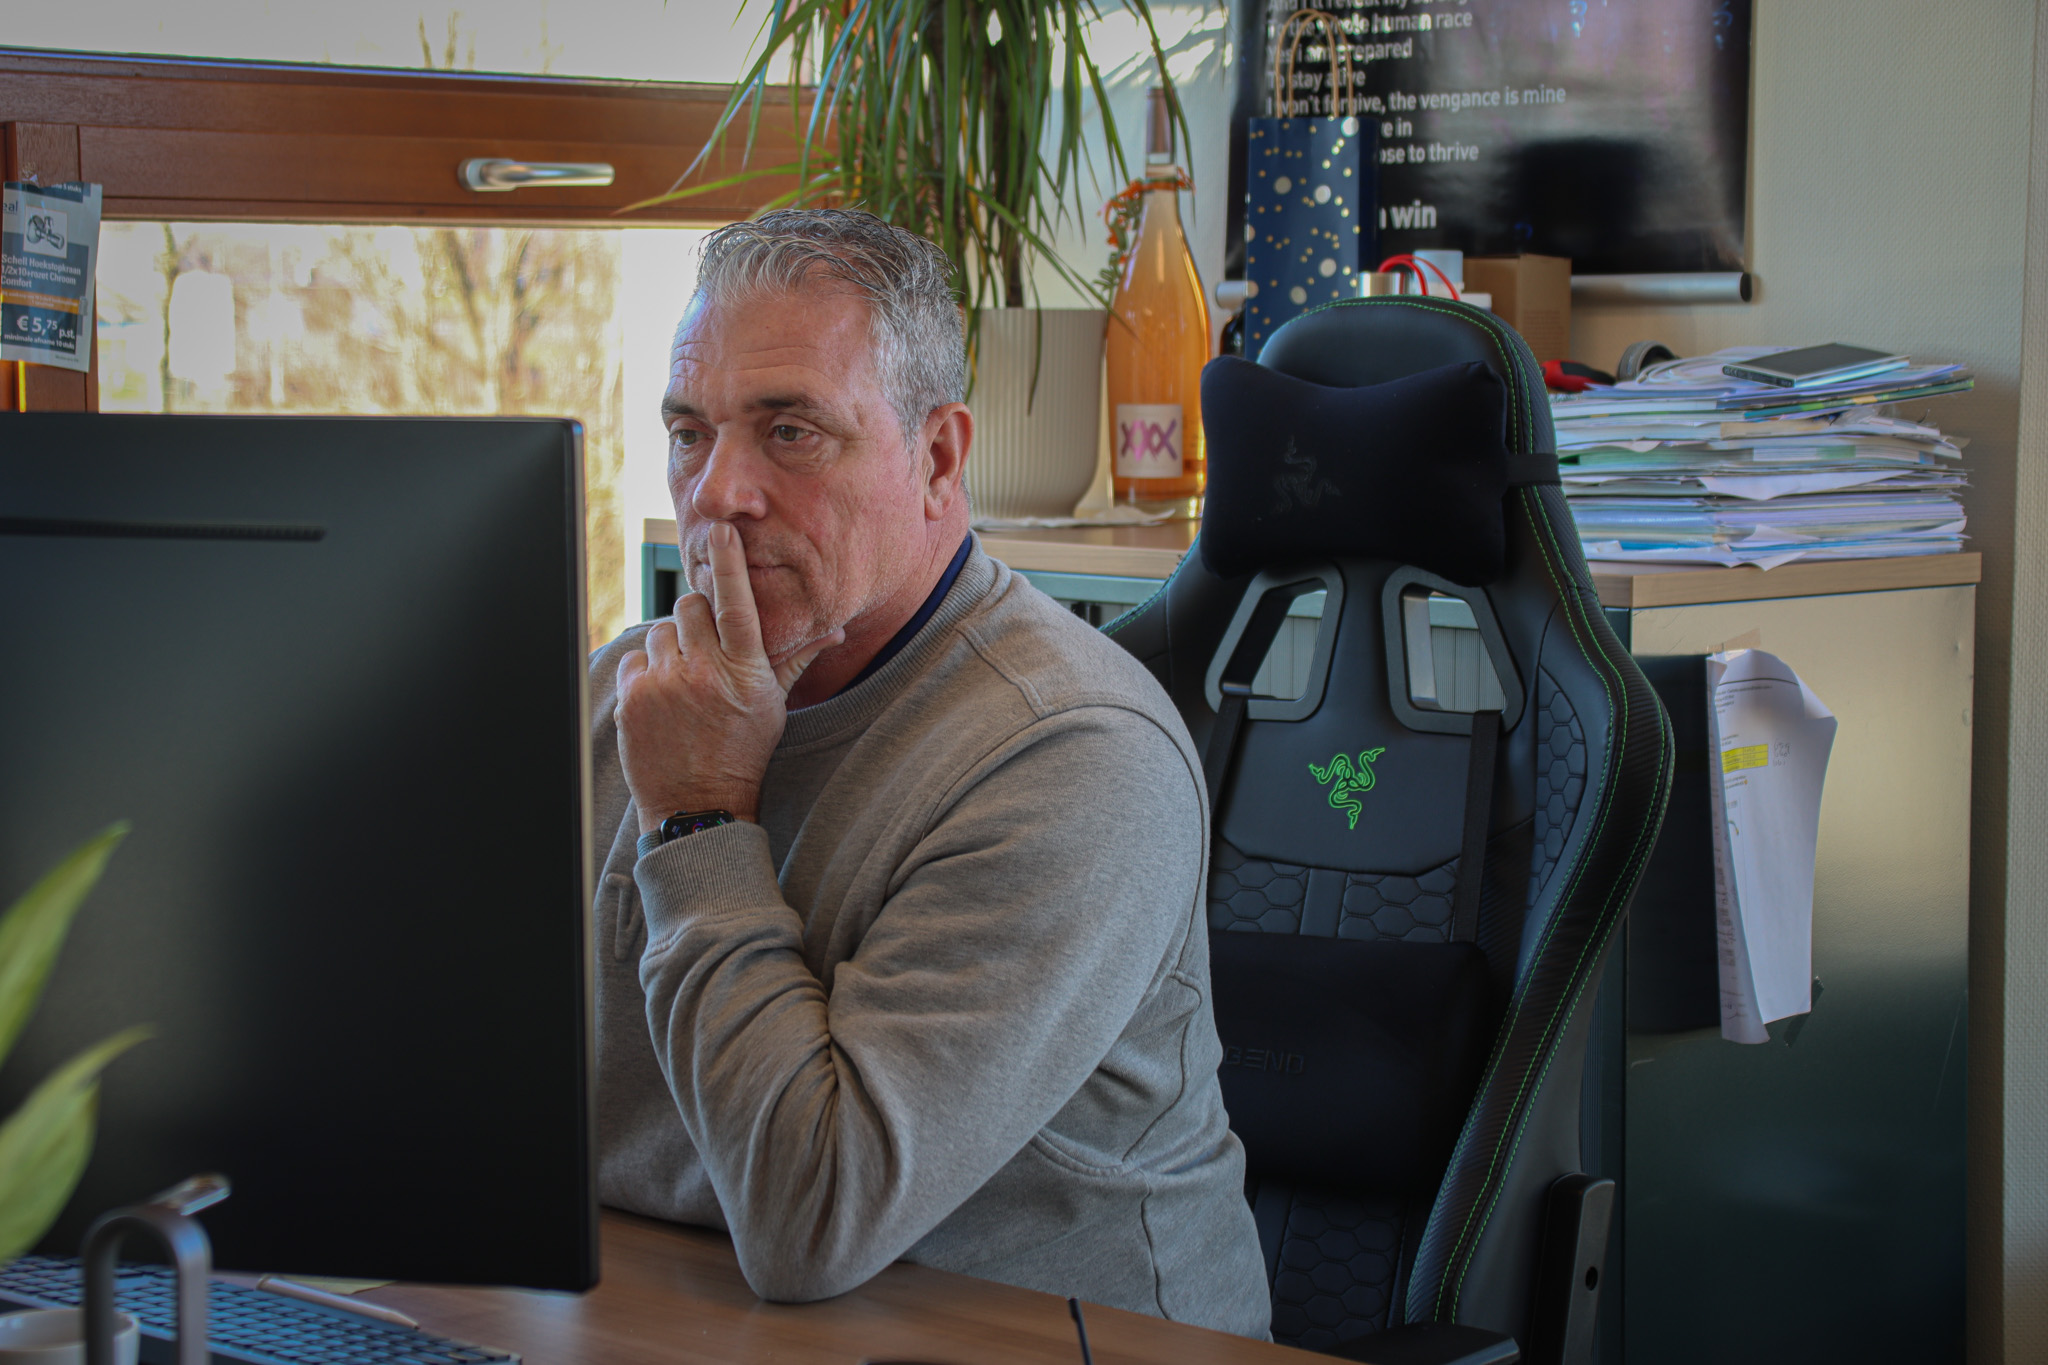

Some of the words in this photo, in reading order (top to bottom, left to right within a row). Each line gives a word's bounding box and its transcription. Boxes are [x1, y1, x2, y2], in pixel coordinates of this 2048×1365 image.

[1371, 11, 1432, 34] human
[1436, 11, 1472, 29] race
[1336, 37, 1412, 65] prepared
[1291, 70, 1322, 93] stay
[1388, 90, 1417, 111] the
[1420, 90, 1500, 113] vengance
[1505, 86, 1519, 105] is
[1523, 84, 1566, 105] mine
[1396, 118, 1413, 137] in
[1408, 143, 1426, 163] to
[1429, 142, 1479, 162] thrive
[1391, 199, 1437, 229] win
[2, 254, 28, 266] Schell
[29, 257, 81, 275] Hoekstopkraan
[1, 276, 32, 288] Comfort
[50, 272, 76, 285] Chroom
[4, 333, 33, 342] minimale
[17, 315, 29, 331] €
[59, 328, 75, 340] p.st.
